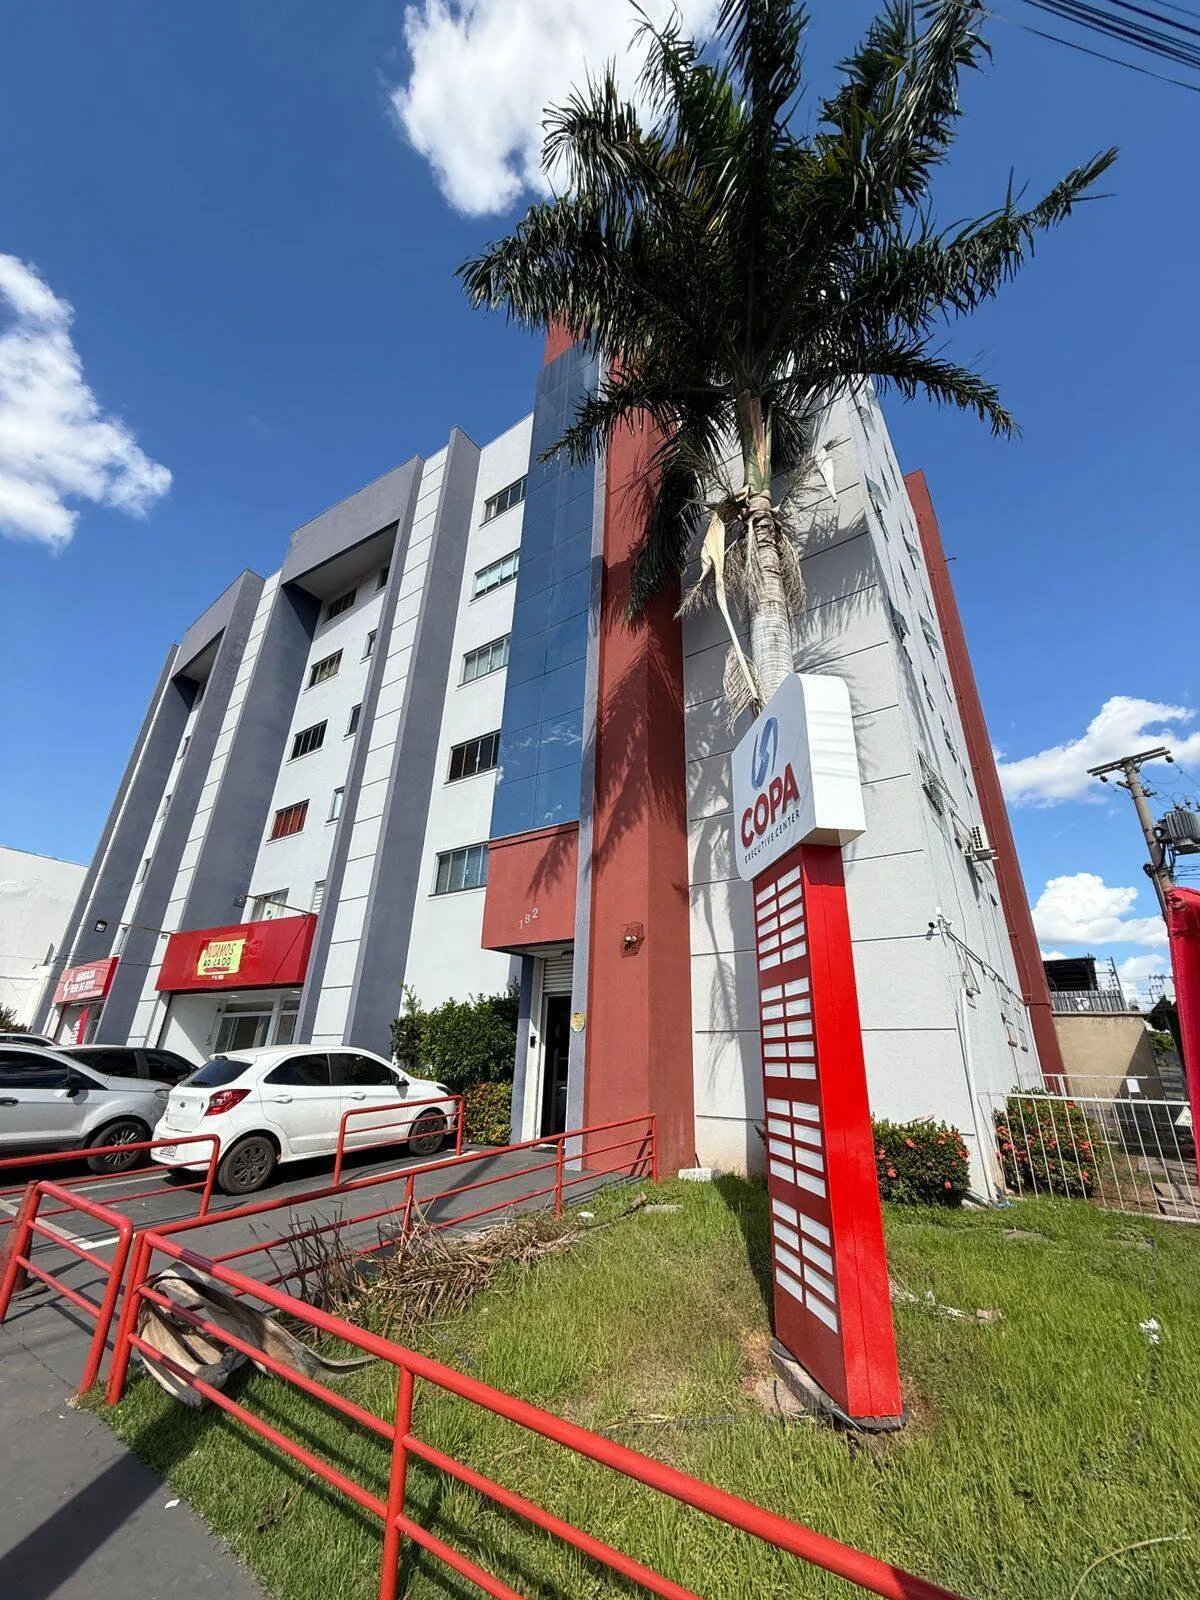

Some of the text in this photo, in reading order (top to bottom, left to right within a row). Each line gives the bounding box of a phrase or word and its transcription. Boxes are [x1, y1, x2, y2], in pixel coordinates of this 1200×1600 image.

[741, 762, 800, 848] COPA
[745, 809, 800, 864] EXECUTIVE CENTER
[519, 907, 539, 930] 182
